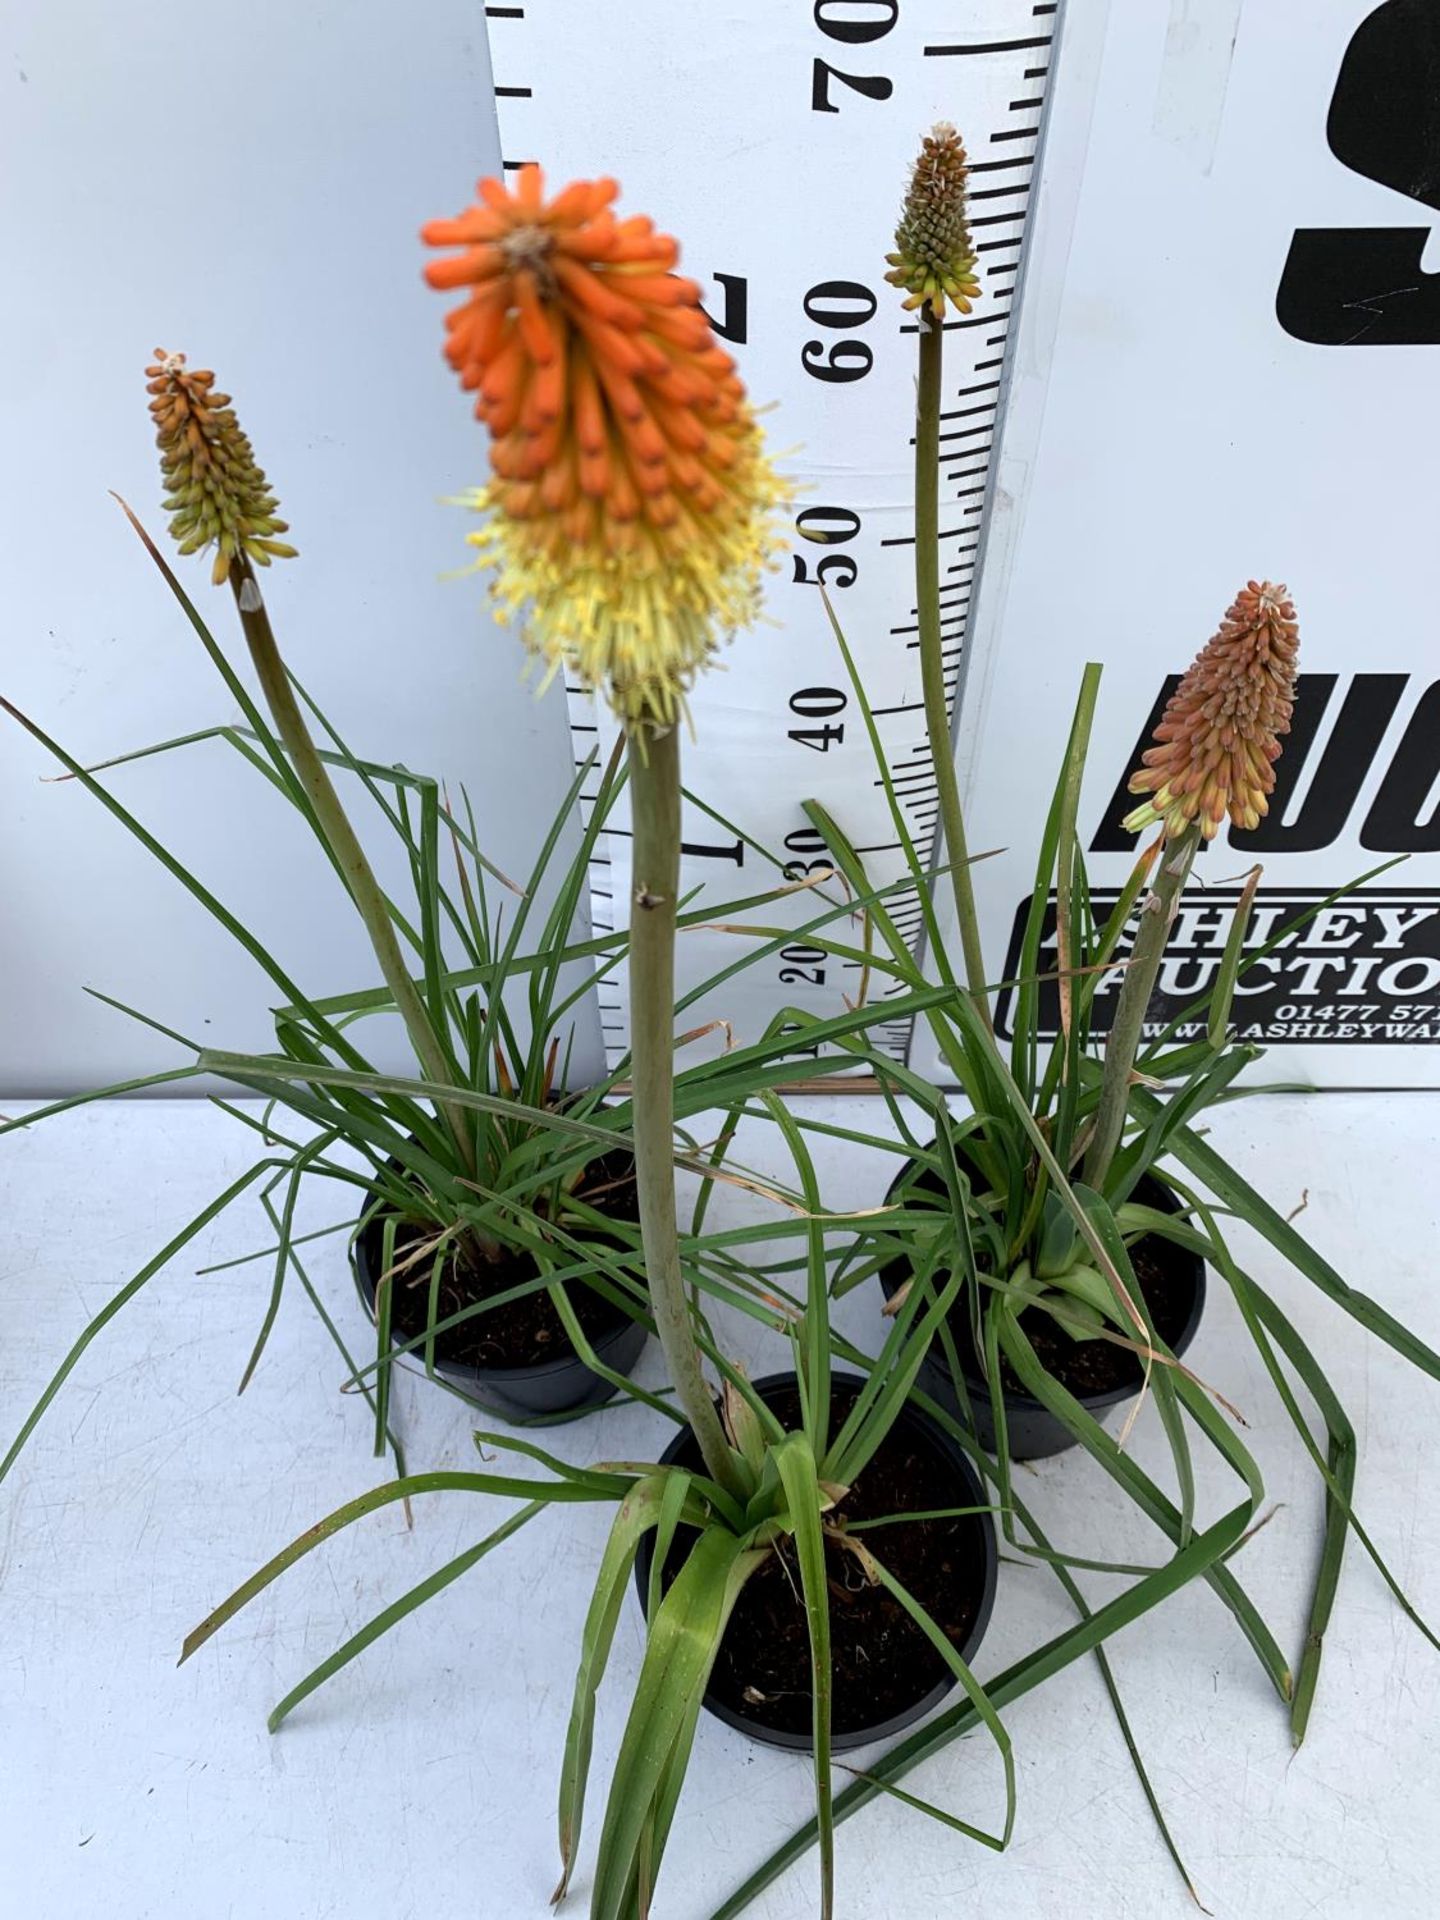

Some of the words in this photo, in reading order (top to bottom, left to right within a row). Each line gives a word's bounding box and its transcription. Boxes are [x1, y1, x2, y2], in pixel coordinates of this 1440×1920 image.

[812, 0, 899, 114] 70
[801, 280, 878, 383] 60
[792, 506, 862, 588] 50
[787, 686, 848, 753] 40
[783, 828, 834, 882] 30
[779, 945, 828, 986] 20
[1274, 1004, 1381, 1021] 01477
